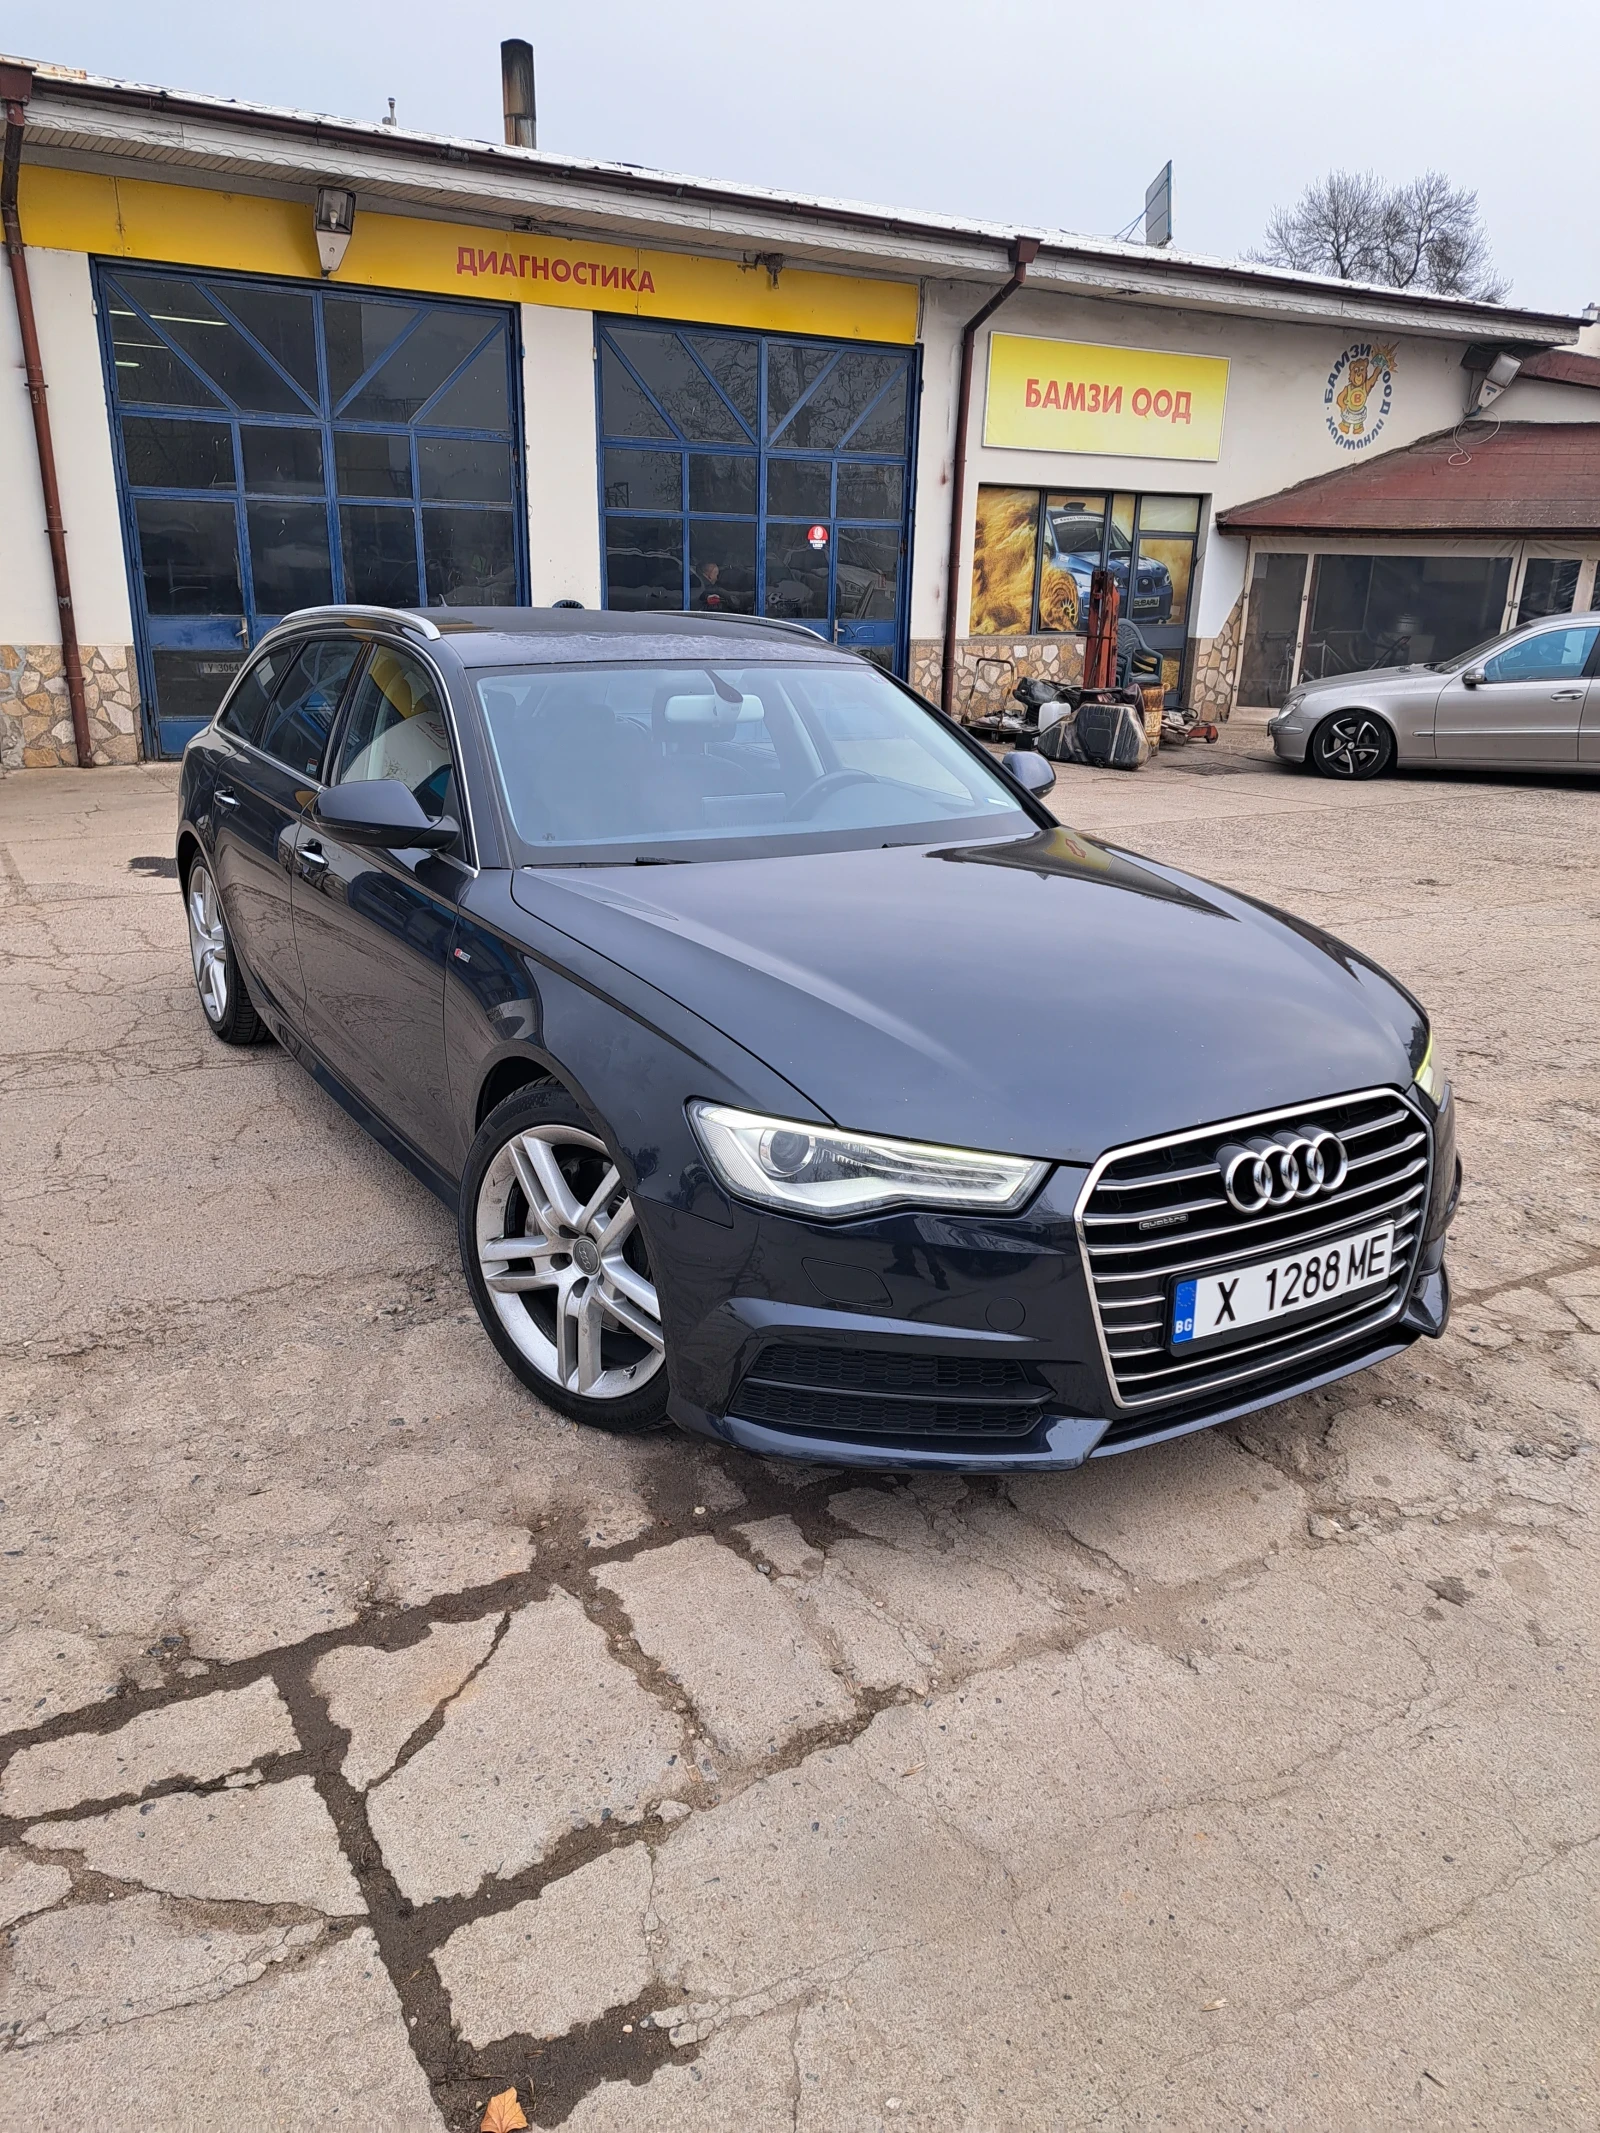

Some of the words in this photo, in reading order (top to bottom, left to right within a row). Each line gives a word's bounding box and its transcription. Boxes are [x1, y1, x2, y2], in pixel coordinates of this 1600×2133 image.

[456, 246, 655, 294] ДИАГНОСТИКА
[1025, 378, 1123, 414] БАМЗИ
[1131, 387, 1192, 425] ООД
[1324, 343, 1372, 404] БАМЗИ
[1380, 370, 1393, 415] ООД
[1141, 1215, 1187, 1229] quattro
[1213, 1277, 1240, 1326] X
[1266, 1249, 1341, 1312] 1288
[1346, 1232, 1389, 1286] ME
[1175, 1318, 1193, 1334] BG
